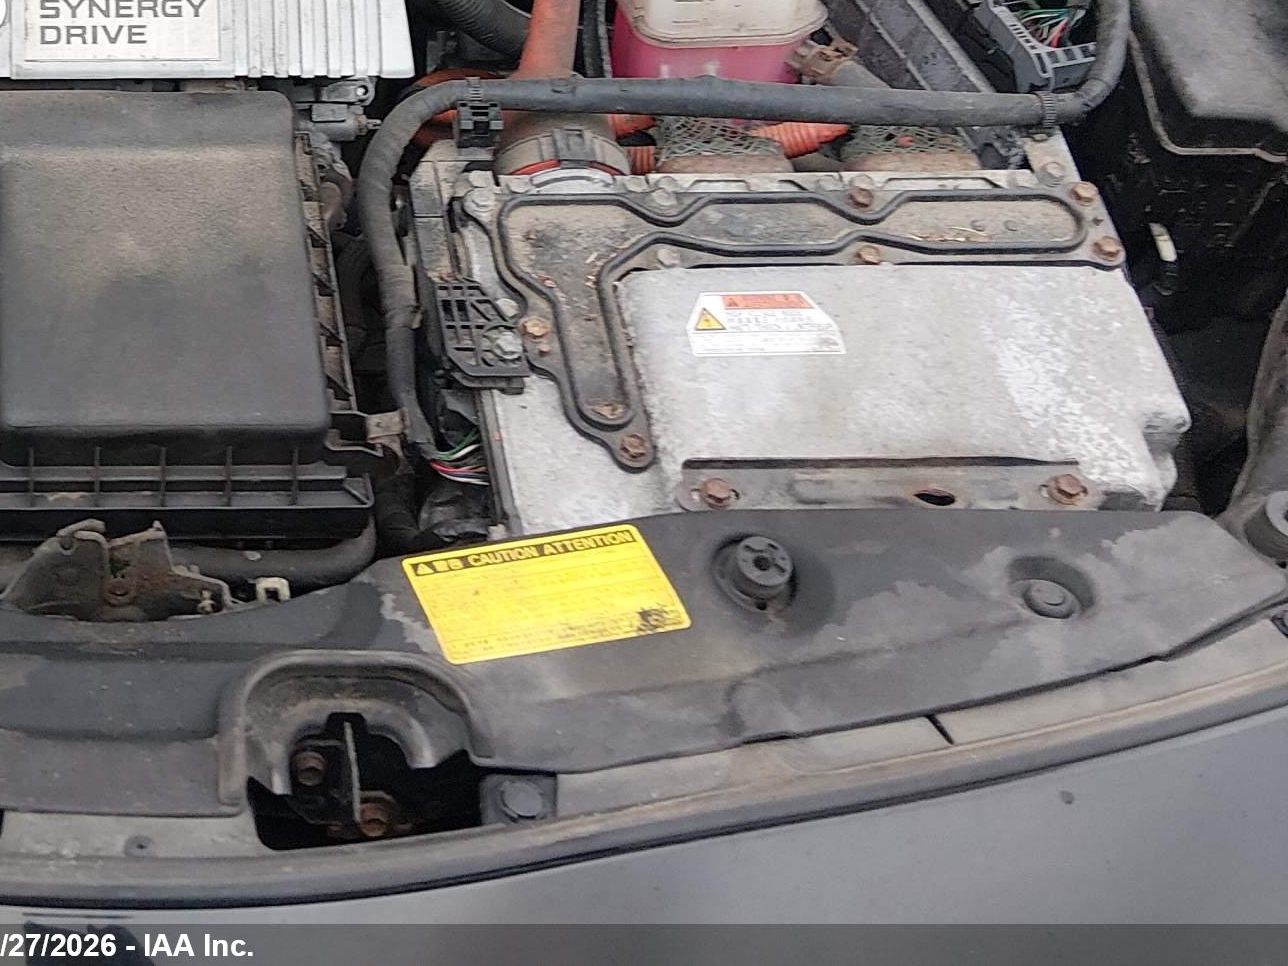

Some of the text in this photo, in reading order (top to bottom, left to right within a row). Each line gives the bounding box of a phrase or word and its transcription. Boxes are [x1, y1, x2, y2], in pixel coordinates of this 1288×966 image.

[39, 25, 148, 45] DRIVE
[468, 546, 538, 567] CAUTION
[542, 531, 634, 555] ATTENTION
